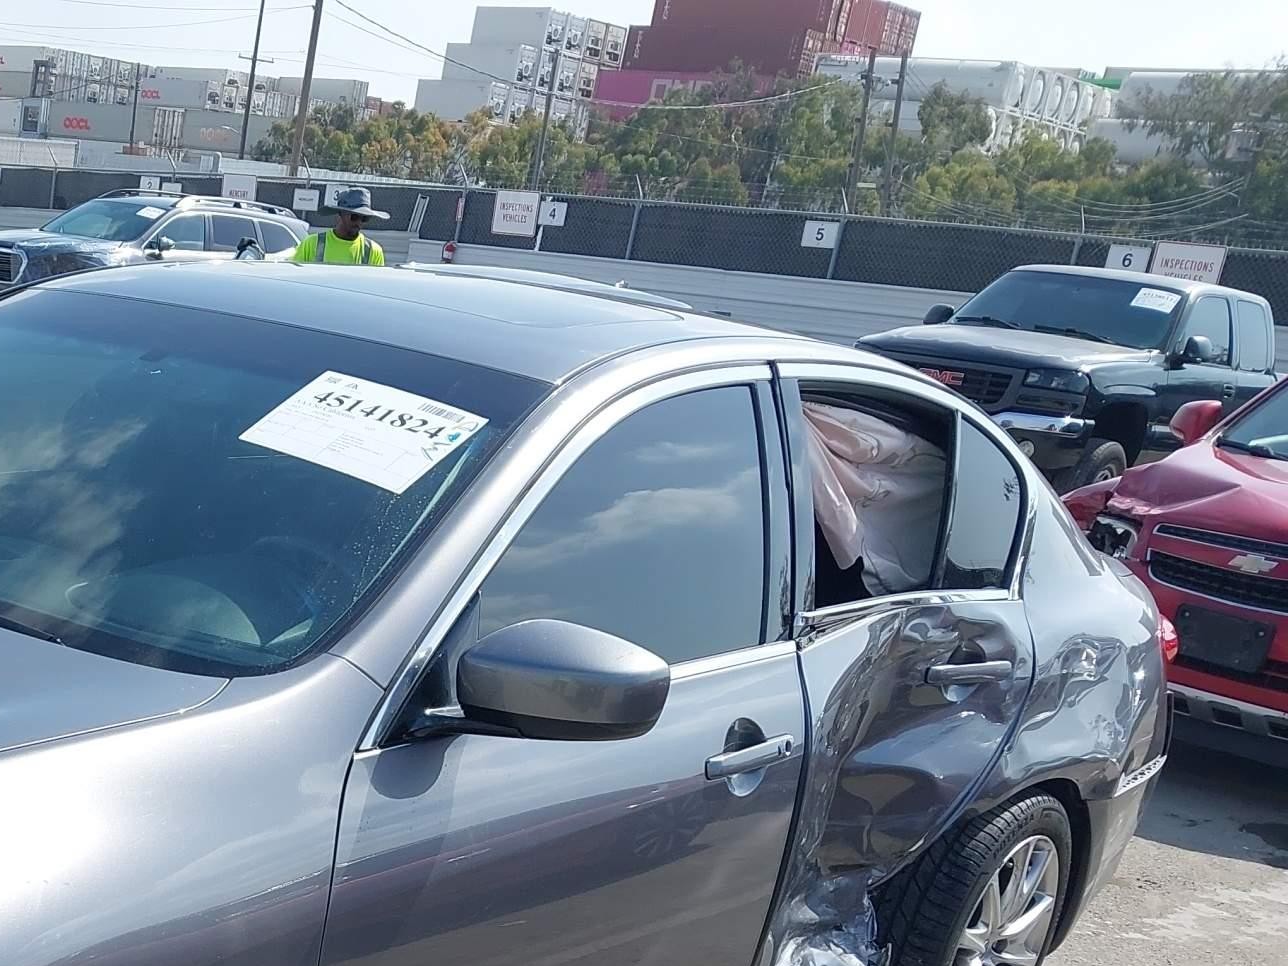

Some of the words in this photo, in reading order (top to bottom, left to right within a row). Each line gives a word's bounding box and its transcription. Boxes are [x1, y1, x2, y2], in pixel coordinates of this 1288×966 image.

[140, 89, 161, 100] OOCL
[63, 116, 91, 131] OOCL
[333, 190, 340, 200] 3
[499, 201, 533, 213] INSPECTIONS
[548, 207, 557, 220] 4
[502, 213, 528, 224] VEHICLES
[815, 227, 825, 241] 5
[1121, 252, 1134, 268] 6
[1160, 258, 1215, 273] INSPECTIONS
[314, 391, 447, 439] 45141824
